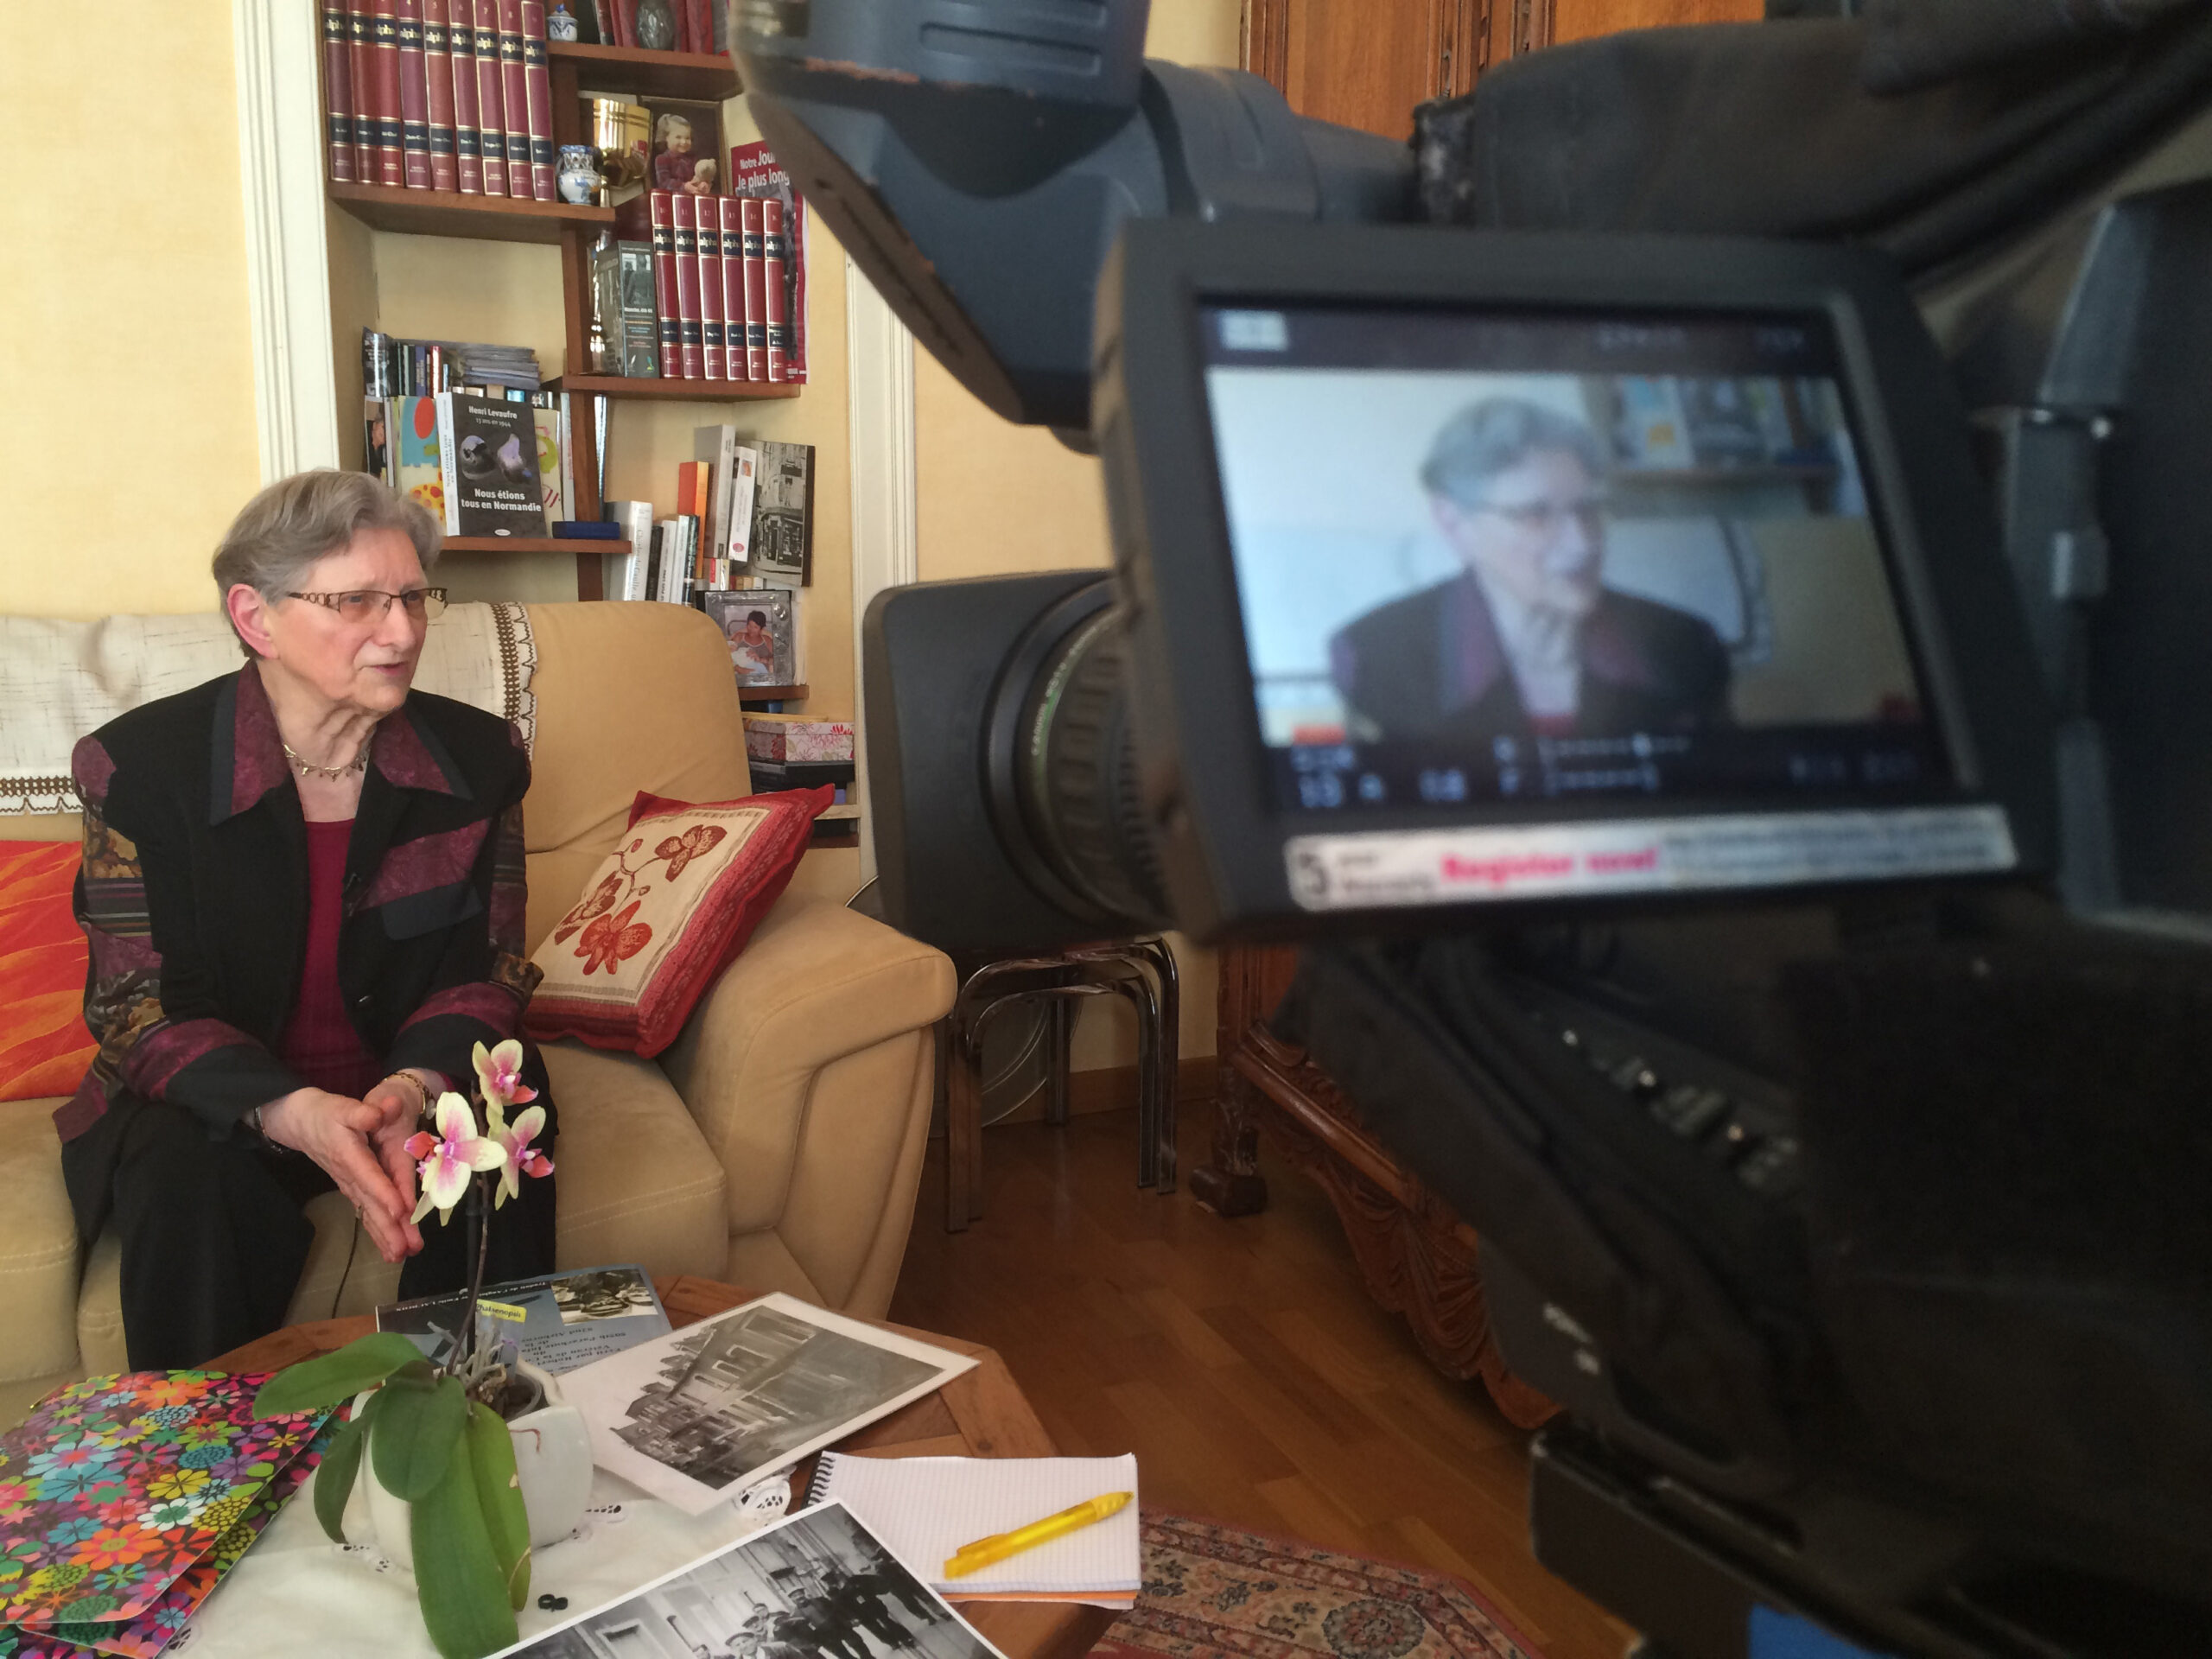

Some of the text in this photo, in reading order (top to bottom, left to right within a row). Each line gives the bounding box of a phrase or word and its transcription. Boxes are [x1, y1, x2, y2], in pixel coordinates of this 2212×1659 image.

[740, 157, 758, 169] Notre
[748, 171, 767, 192] plus
[768, 168, 791, 187] long
[468, 405, 518, 419] Henri Levaufre
[474, 488, 525, 500] Nous étions
[461, 499, 480, 509] tous
[493, 501, 542, 512] Normandie
[1440, 849, 1575, 890] Register
